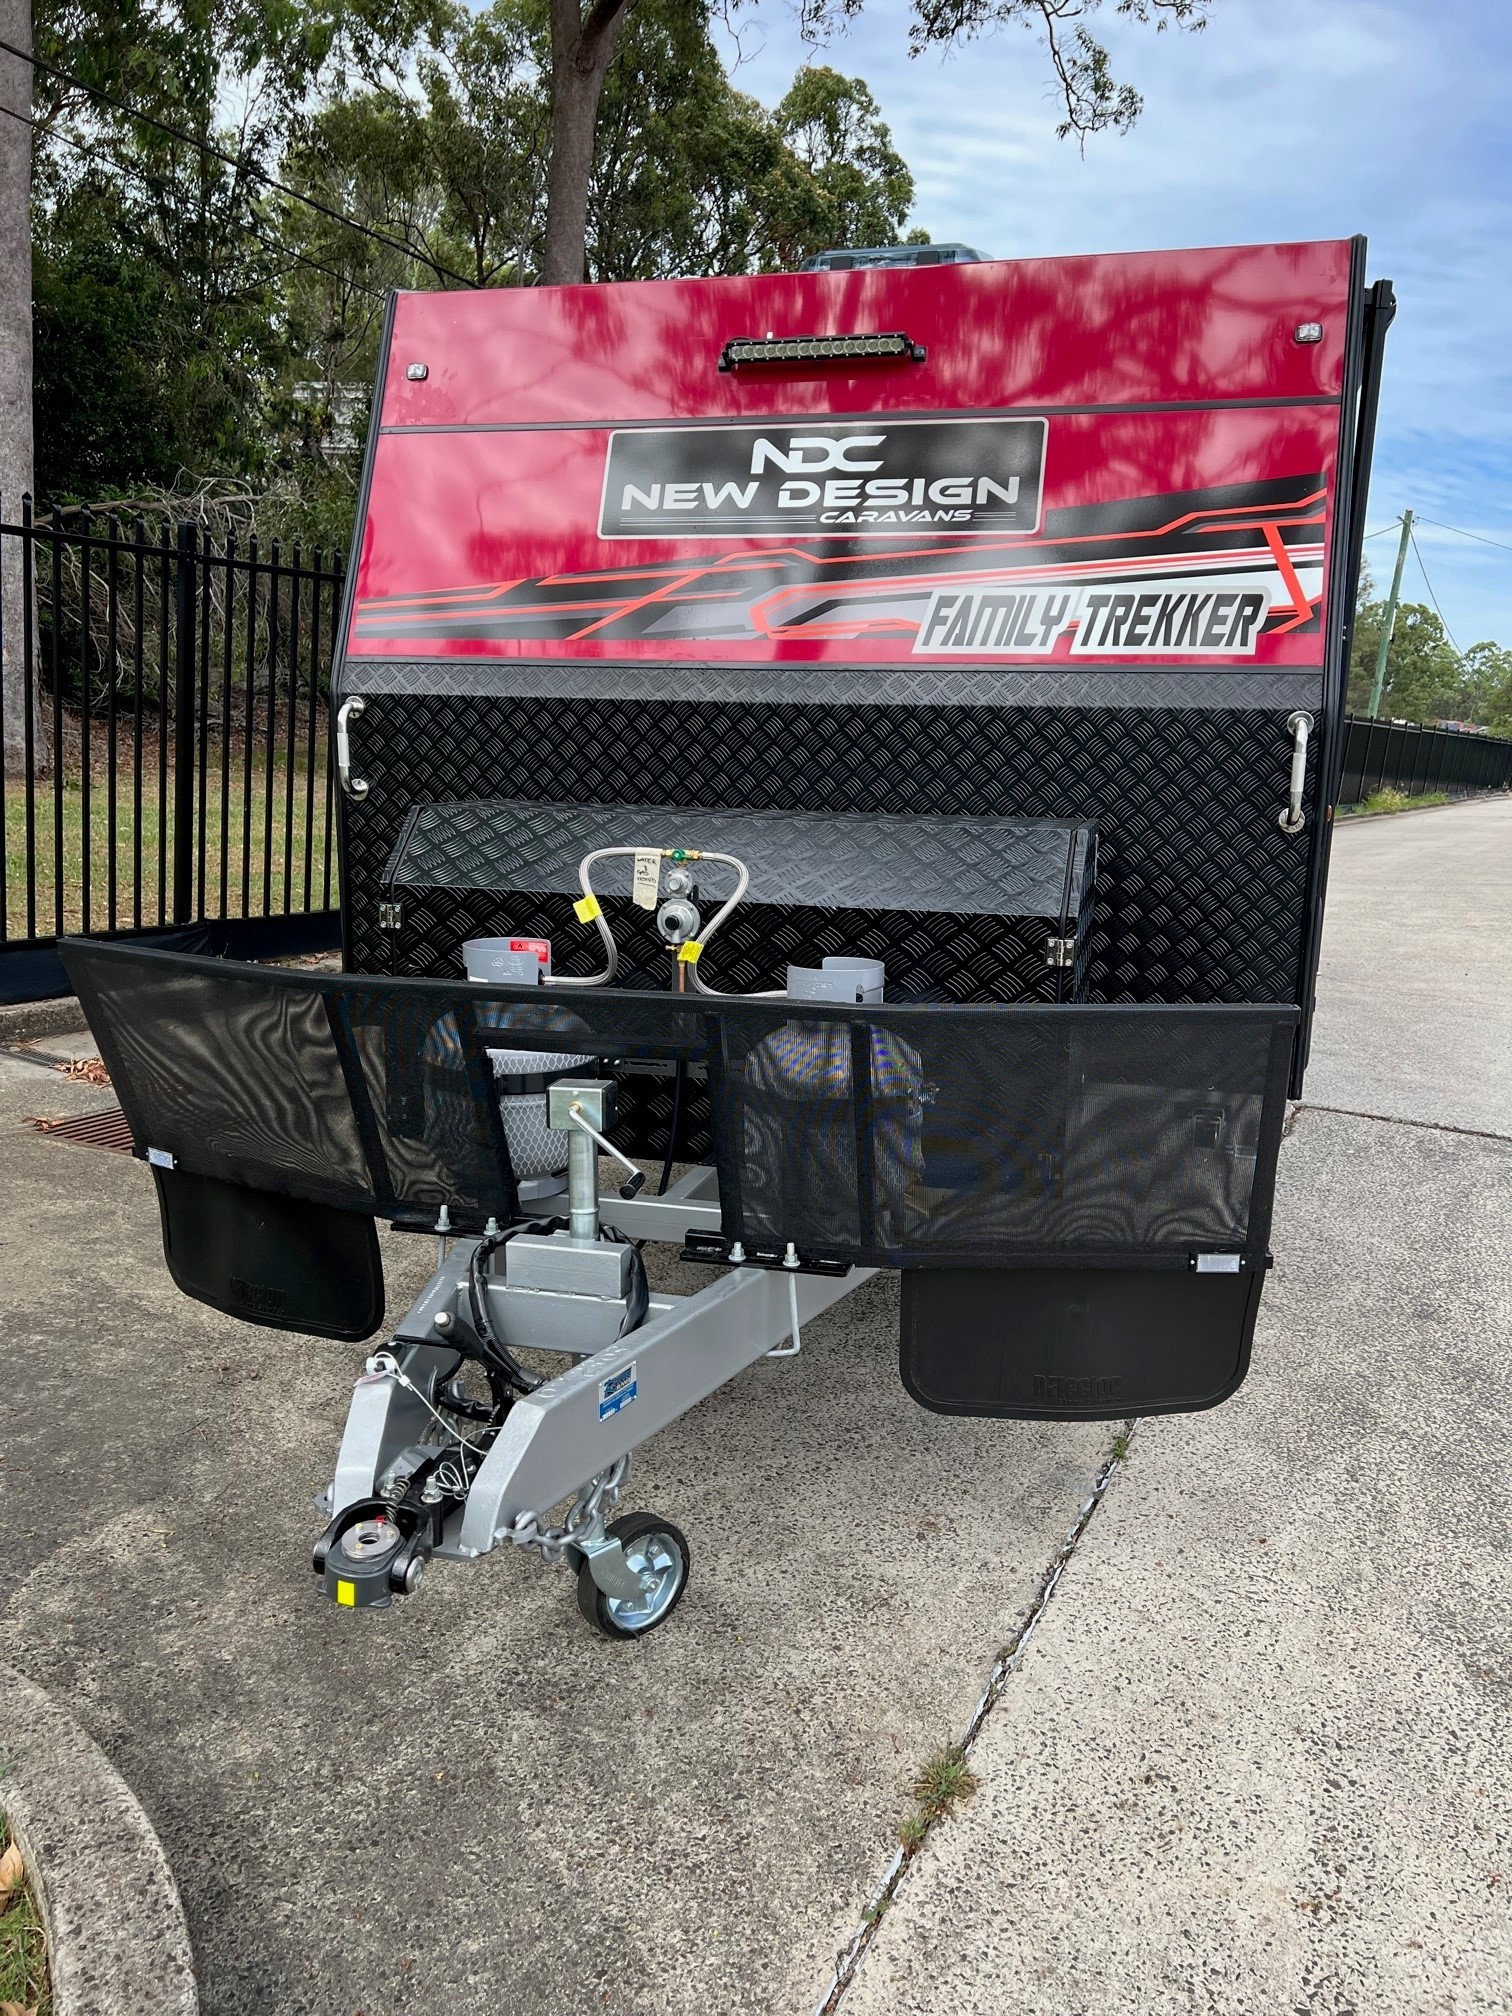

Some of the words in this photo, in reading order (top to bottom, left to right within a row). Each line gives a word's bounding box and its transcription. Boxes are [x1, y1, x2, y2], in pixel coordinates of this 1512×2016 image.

[750, 435, 888, 475] NDC
[621, 480, 760, 511] NEW
[777, 476, 1021, 509] DESIGN
[819, 509, 975, 525] CARAVANS
[920, 593, 1068, 648] FAMILY
[1079, 592, 1265, 648] TREKKER
